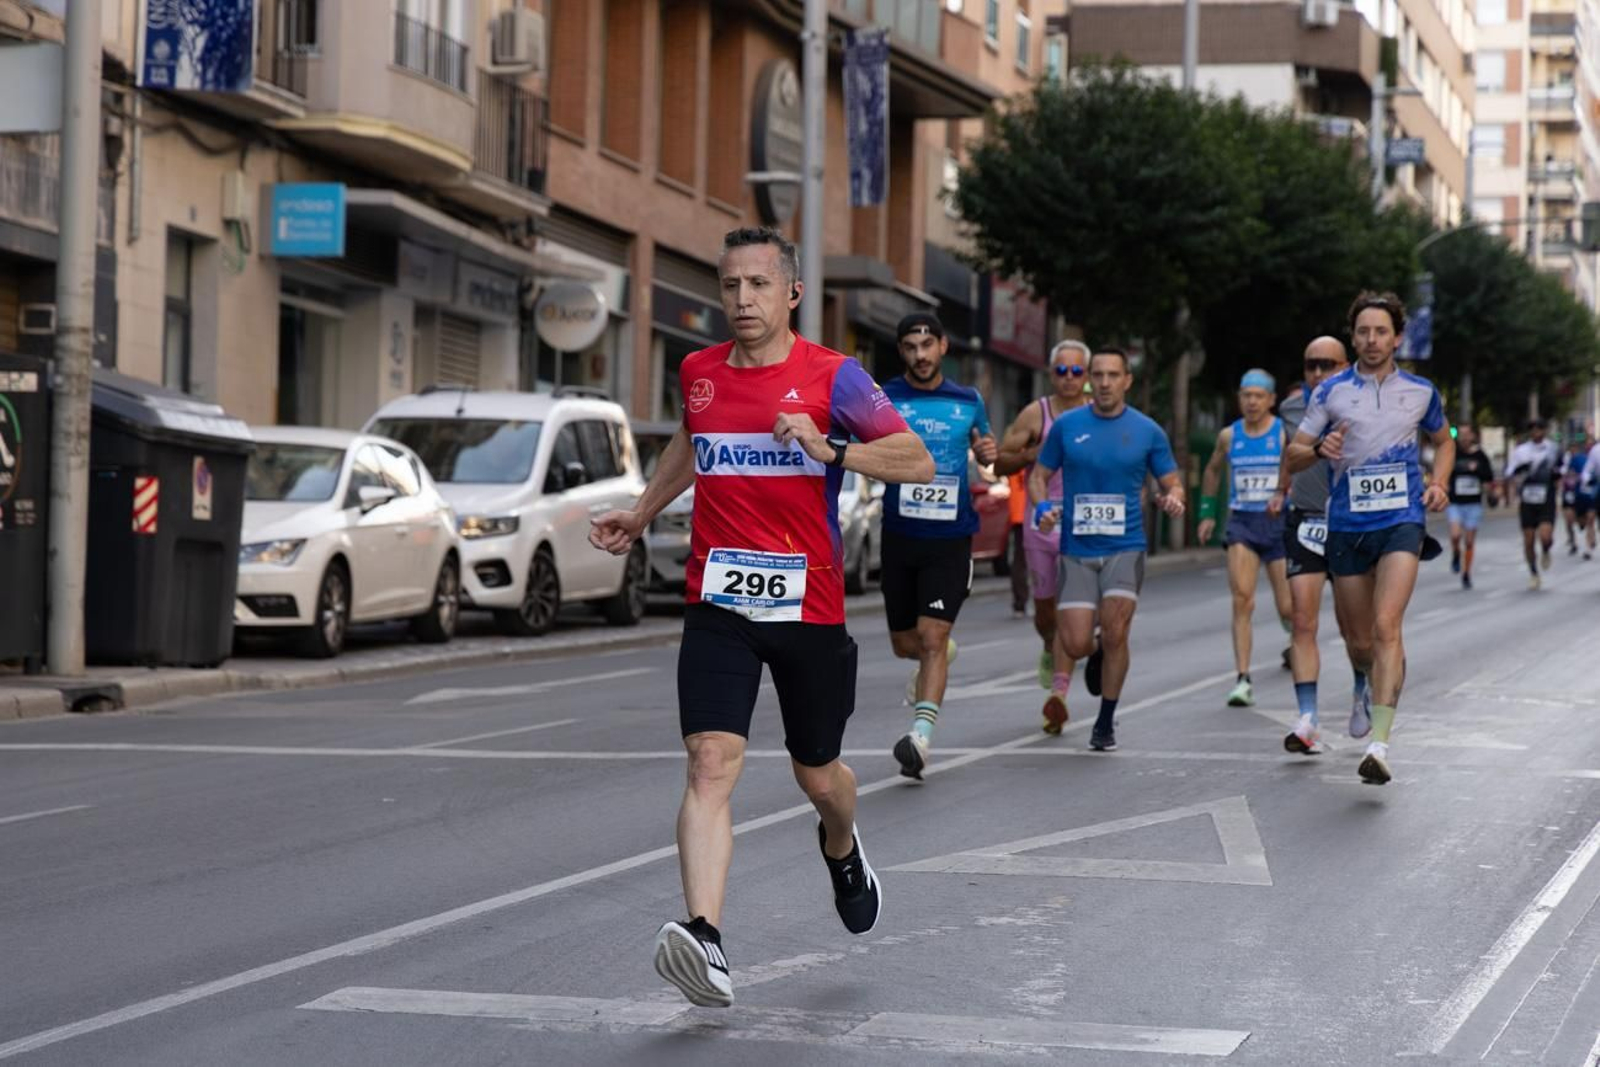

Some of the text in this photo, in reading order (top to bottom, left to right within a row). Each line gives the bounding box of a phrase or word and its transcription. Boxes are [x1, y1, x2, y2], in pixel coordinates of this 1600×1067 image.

[718, 445, 804, 466] Avanza
[1242, 477, 1269, 488] 177
[1360, 477, 1397, 494] 904
[912, 487, 948, 503] 622
[1082, 506, 1116, 520] 339
[723, 570, 787, 598] 296
[751, 598, 775, 606] CARLOS
